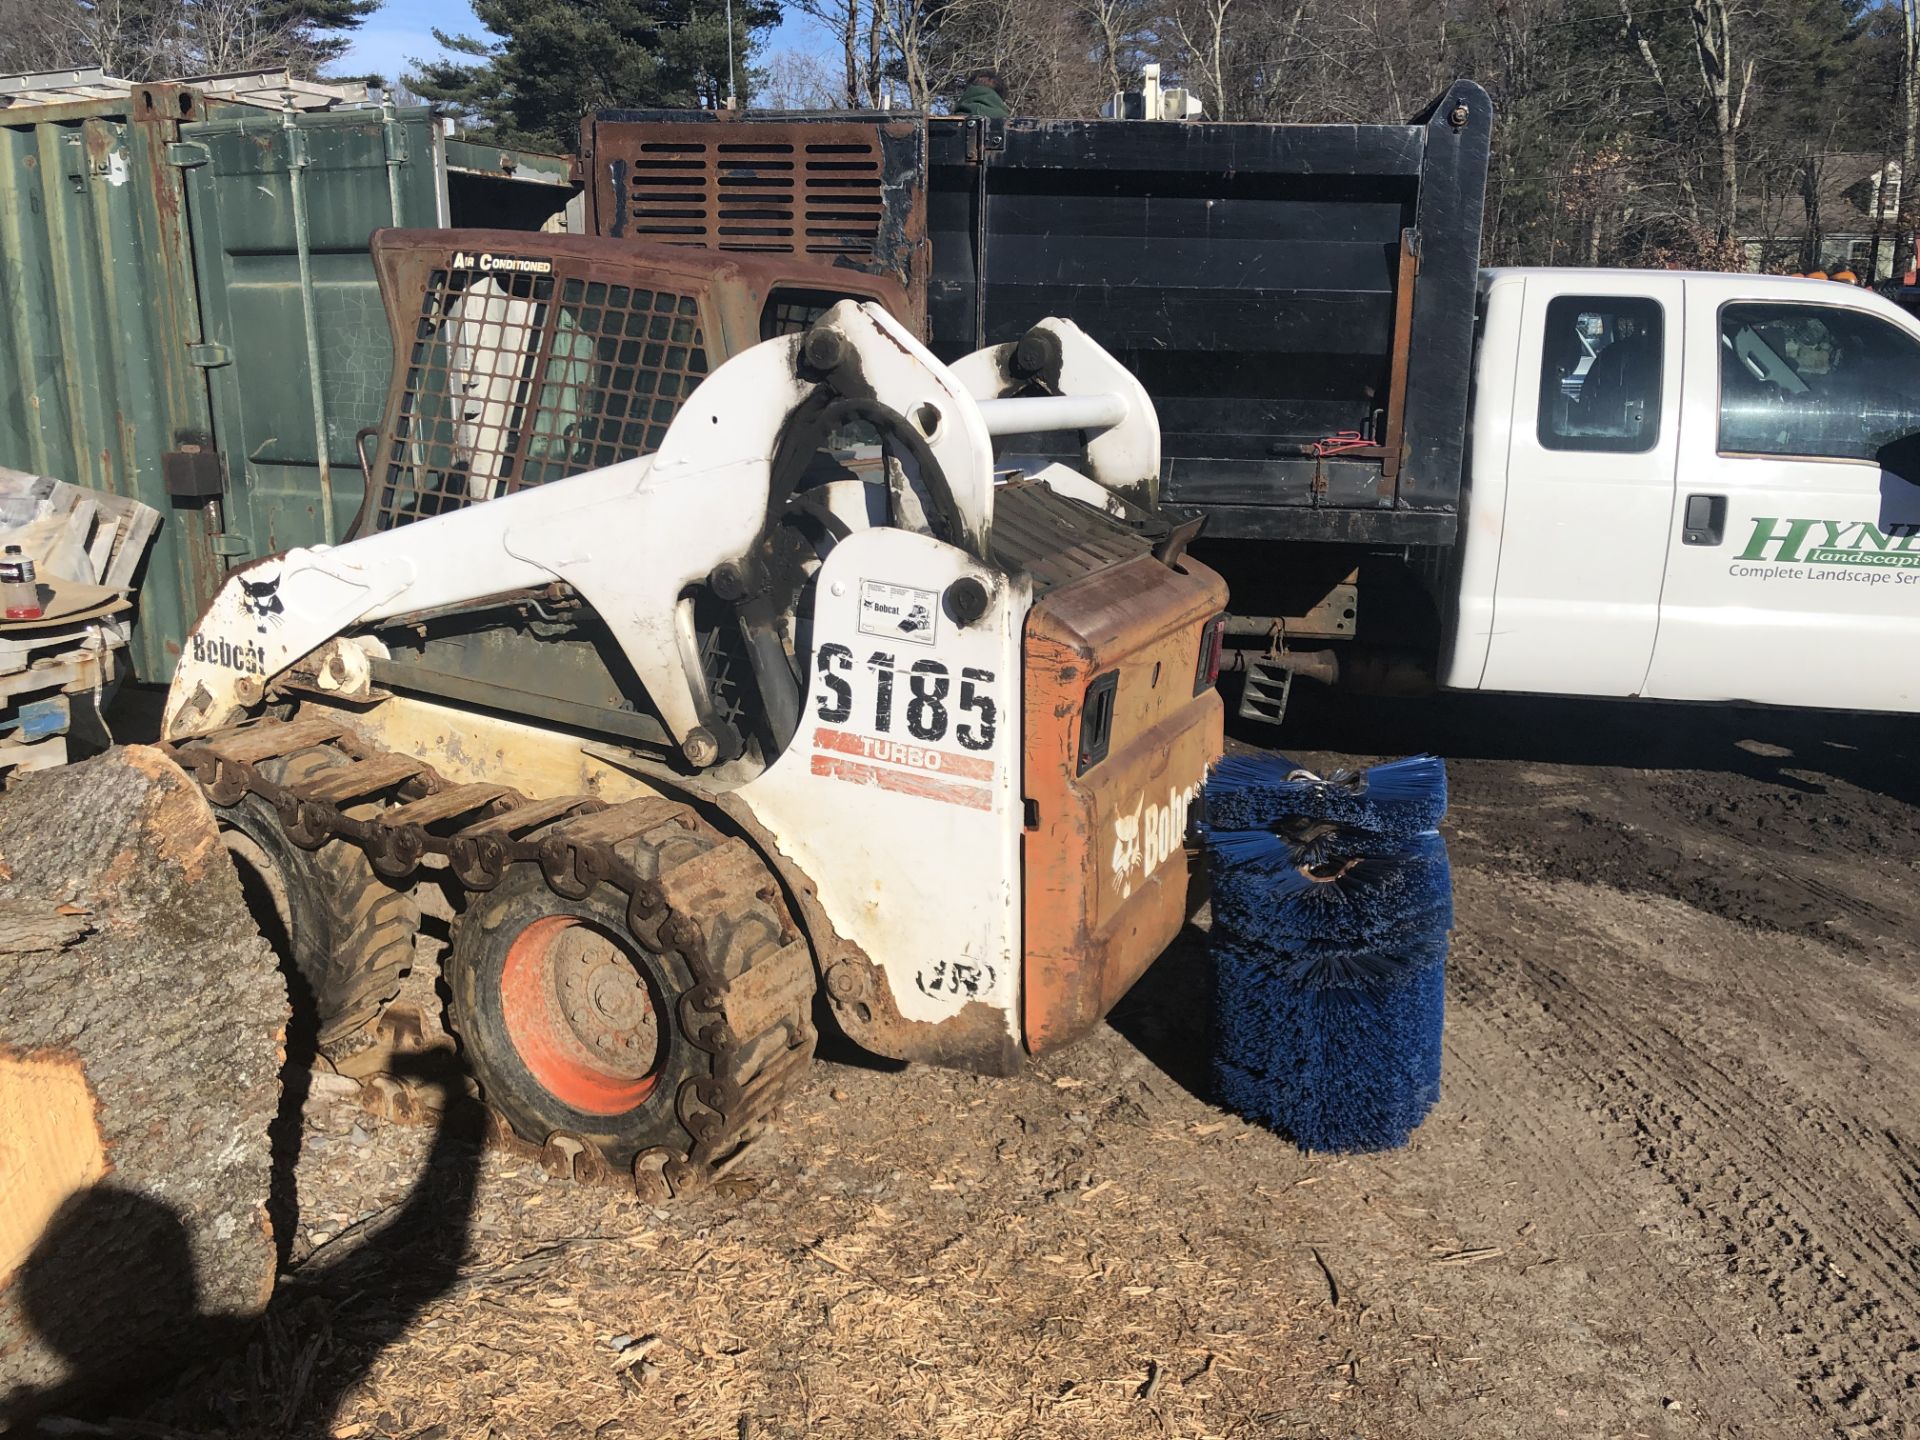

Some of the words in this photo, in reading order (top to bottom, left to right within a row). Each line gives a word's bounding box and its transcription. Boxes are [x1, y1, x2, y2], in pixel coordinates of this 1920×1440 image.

[1729, 564, 1803, 581] Complete
[1807, 567, 1891, 586] Landscape
[874, 602, 900, 616] Bobcat
[193, 632, 266, 676] Bobcat
[816, 642, 998, 751] S185
[862, 736, 942, 771] TURBO
